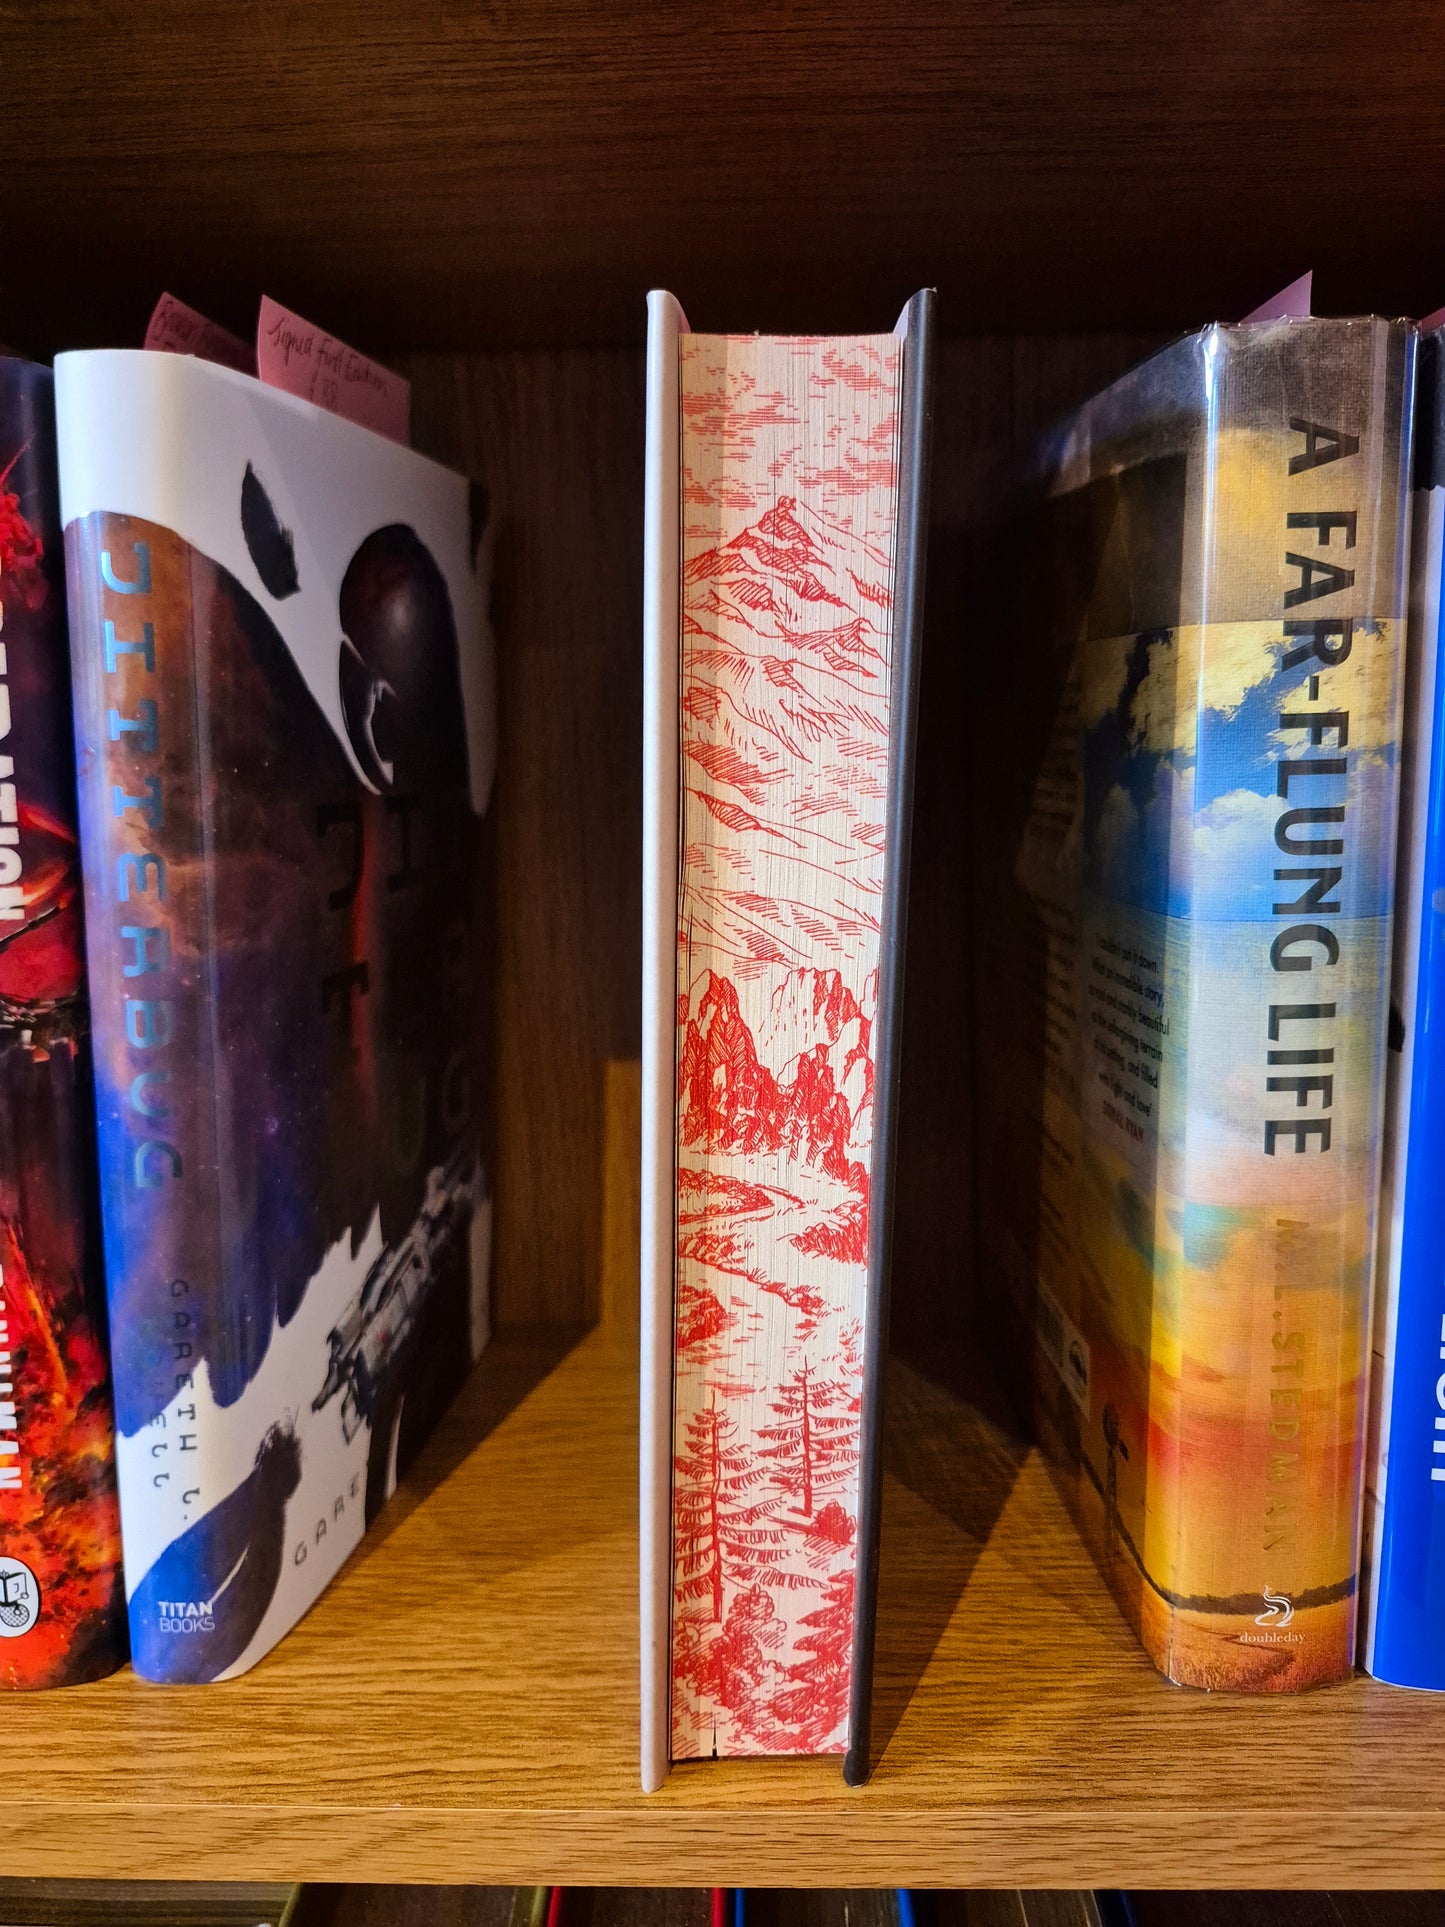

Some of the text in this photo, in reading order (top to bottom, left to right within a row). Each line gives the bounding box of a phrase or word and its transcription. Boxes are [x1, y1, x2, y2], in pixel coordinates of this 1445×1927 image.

[100, 542, 183, 1189] JITTERBUG
[1264, 416, 1360, 1157] A FAR-FLUNG LIFE
[170, 1280, 198, 1451] GARETH
[1262, 1331, 1306, 1553] STEDMAN
[157, 1600, 213, 1618] TITAN
[159, 1616, 216, 1634] BOOKS
[1239, 1631, 1306, 1644] doubleday
